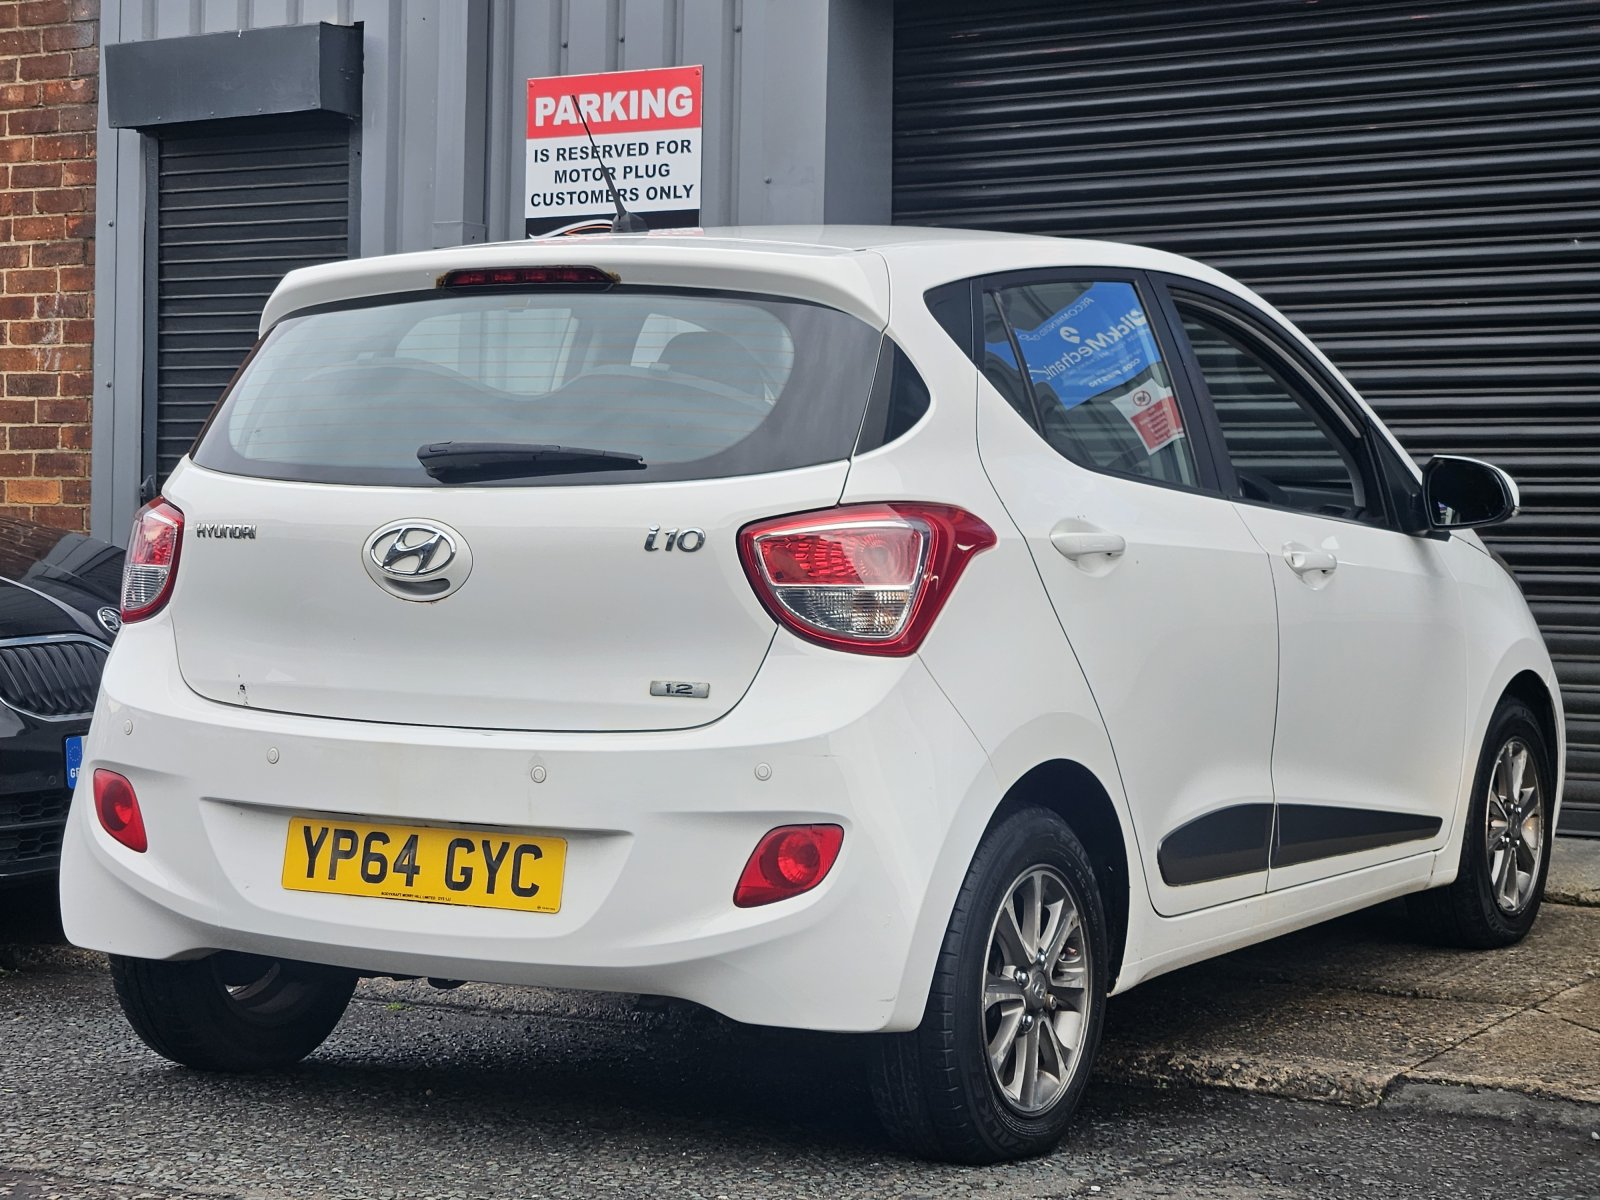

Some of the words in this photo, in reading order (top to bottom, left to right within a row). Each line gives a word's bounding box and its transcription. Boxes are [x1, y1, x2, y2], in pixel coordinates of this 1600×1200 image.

[535, 86, 693, 127] PARKING
[534, 148, 550, 163] IS
[556, 142, 649, 162] RESERVED
[656, 139, 692, 155] FOR
[554, 166, 617, 184] MOTOR
[623, 163, 670, 180] PLUG
[531, 187, 639, 207] CUSTOMERS
[646, 184, 694, 200] ONLY
[196, 523, 257, 539] HYUNDAI
[644, 522, 707, 553] i10
[665, 683, 693, 695] 1.2
[303, 825, 421, 887] YP64
[444, 837, 544, 898] GYC
